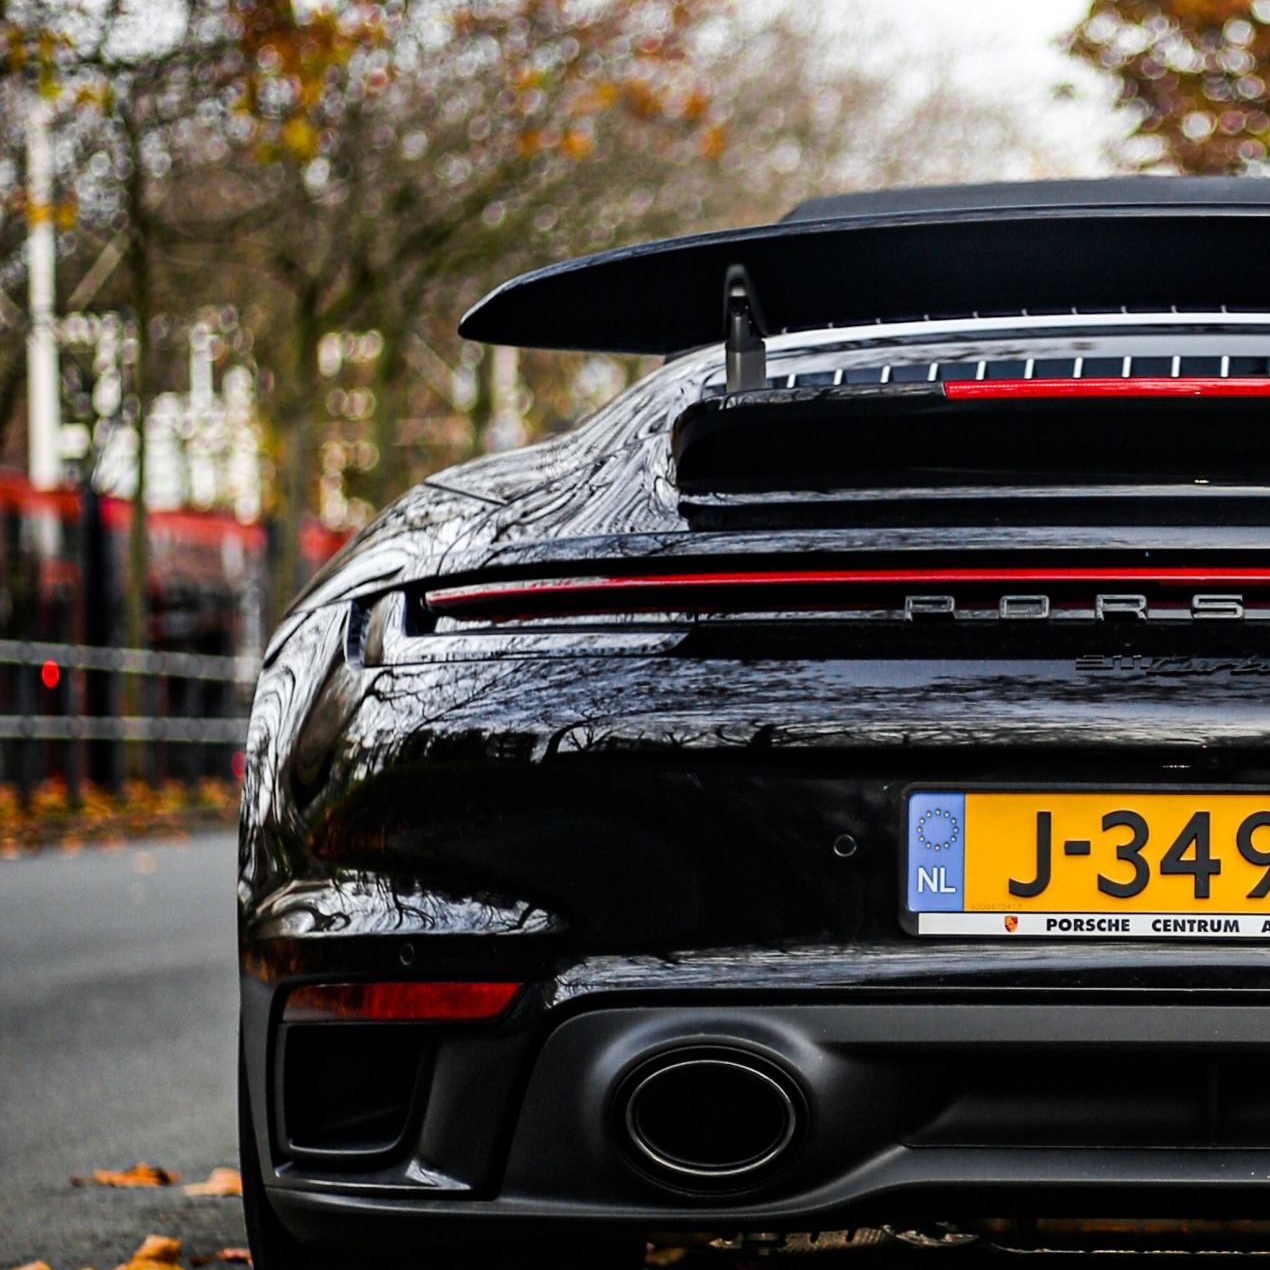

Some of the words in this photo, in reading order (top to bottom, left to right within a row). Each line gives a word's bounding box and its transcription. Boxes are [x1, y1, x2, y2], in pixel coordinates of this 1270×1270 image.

[917, 866, 956, 893] NL
[1045, 918, 1131, 932] PORSCHE
[1151, 918, 1240, 933] CENTRUM
